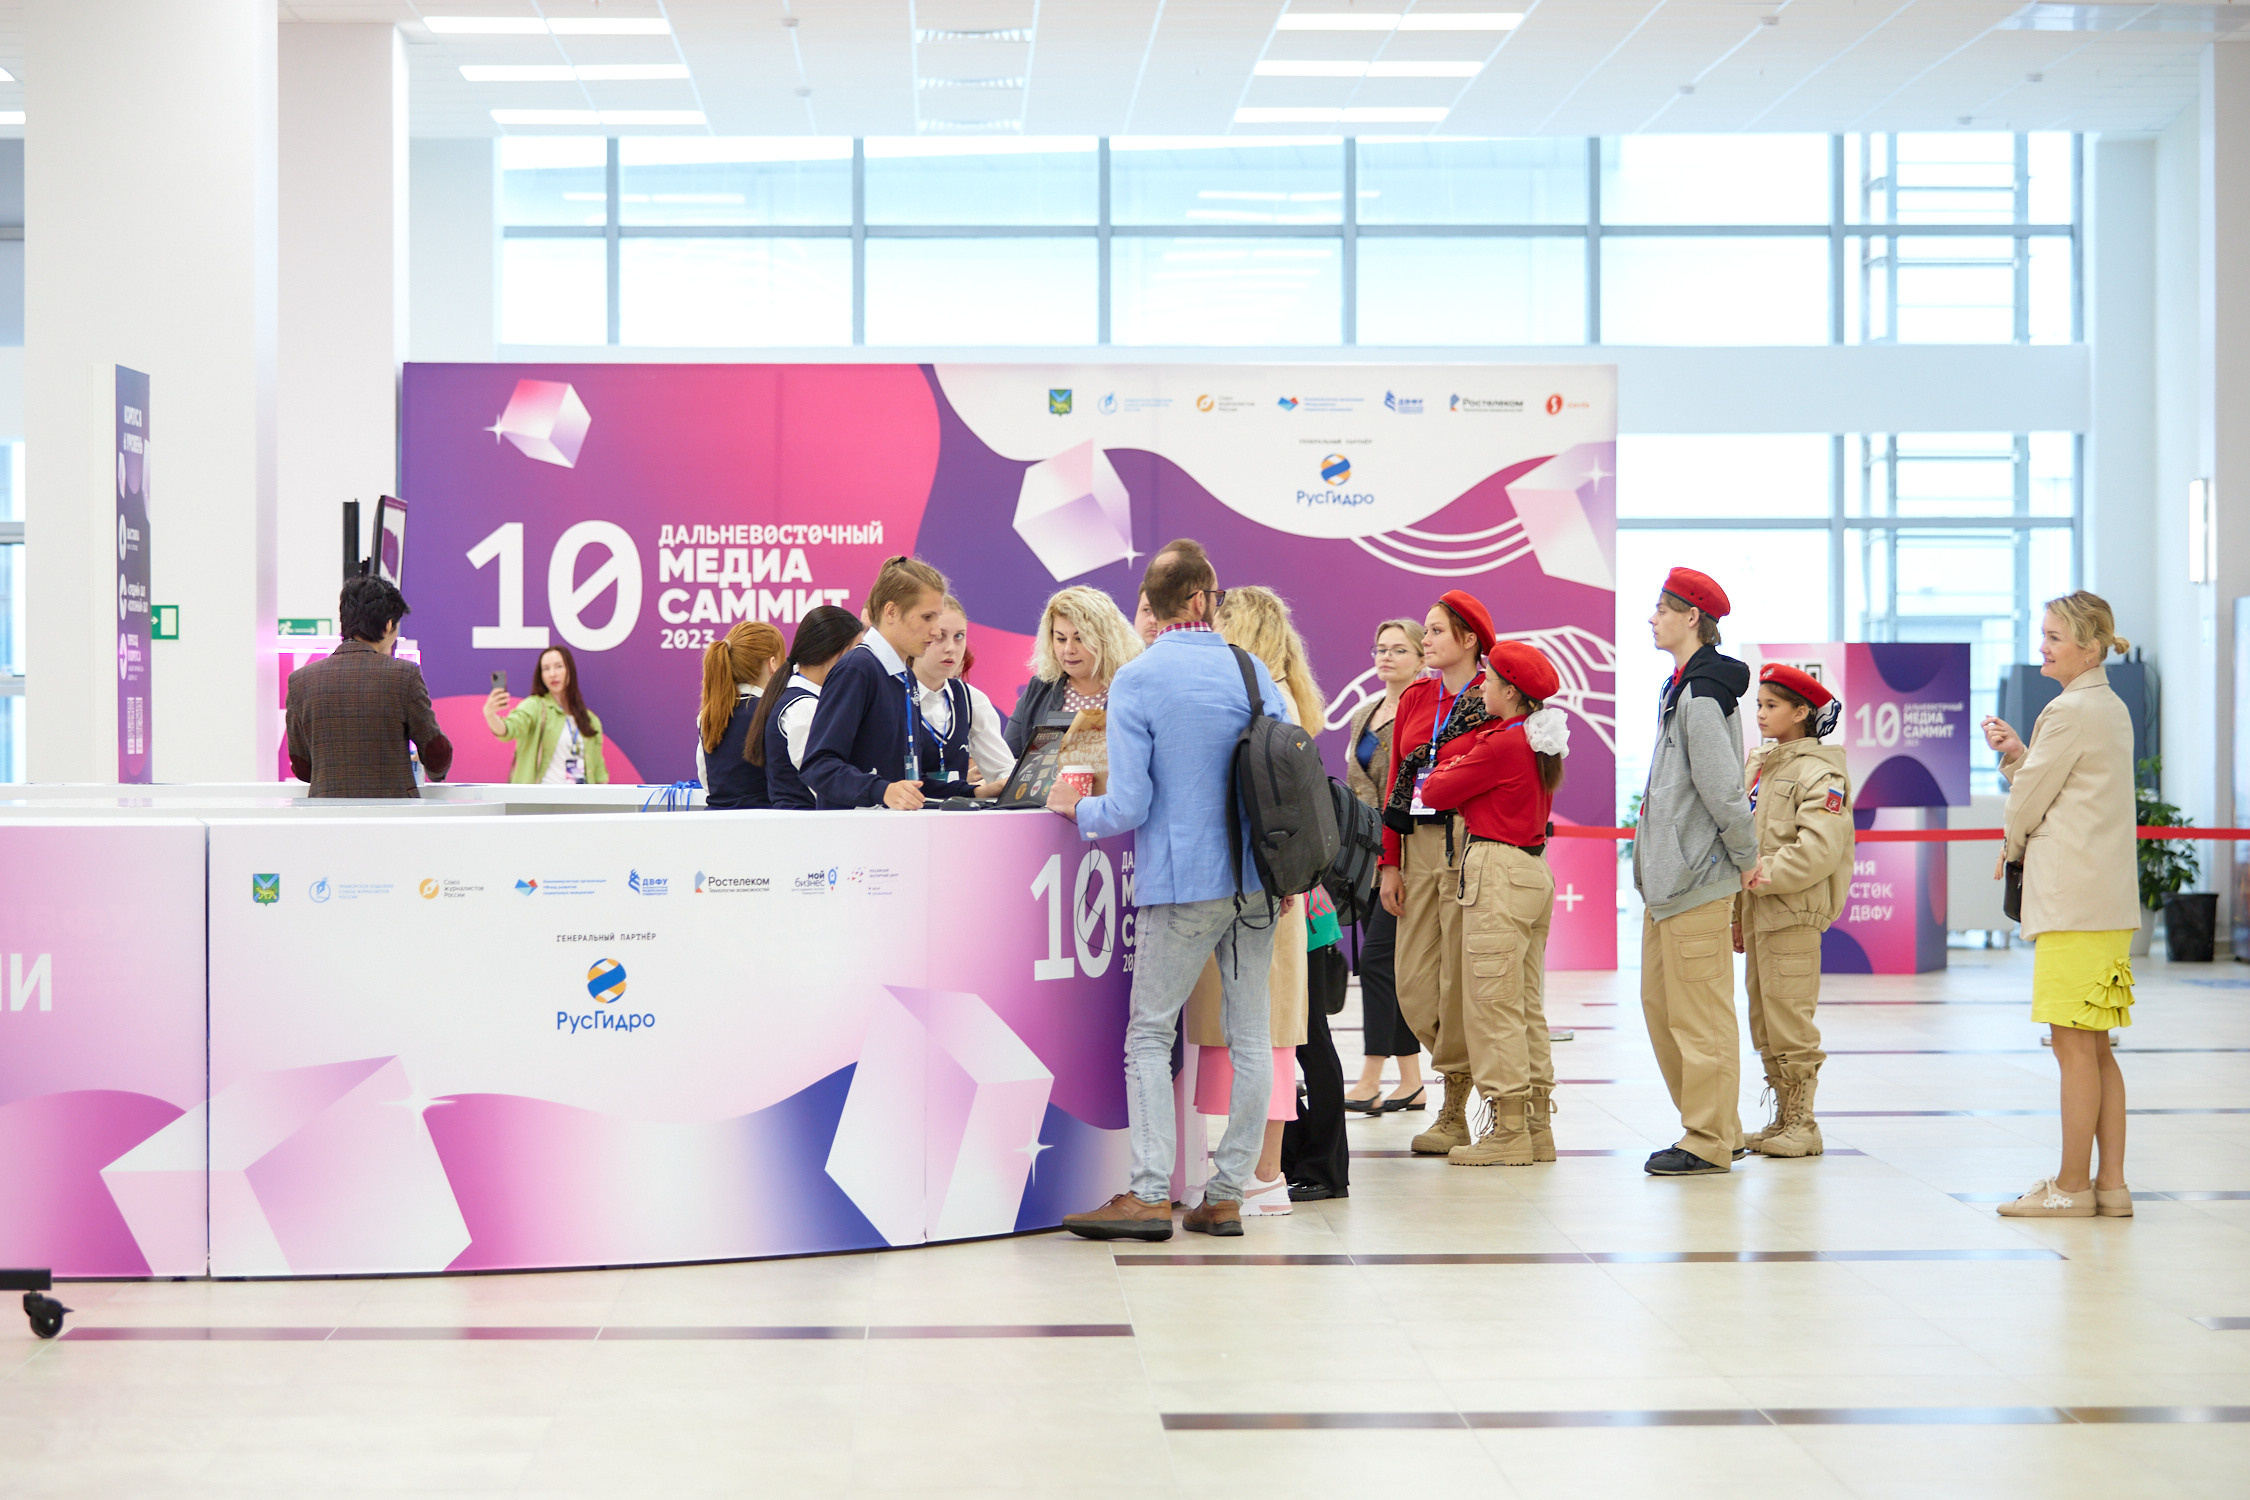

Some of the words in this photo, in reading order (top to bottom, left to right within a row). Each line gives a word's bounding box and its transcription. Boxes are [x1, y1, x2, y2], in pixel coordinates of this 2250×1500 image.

[1296, 490, 1375, 507] РусГидро
[658, 521, 884, 547] ДАЛЬНЕВОСТОЧНЫЙ
[658, 548, 813, 589] МЕДИА
[466, 520, 643, 652] 10
[657, 588, 850, 625] САММИТ
[660, 628, 716, 649] 2023
[1854, 701, 1901, 748] 10
[1903, 712, 1944, 726] МЕДИА
[1903, 724, 1954, 738] САММИТ
[1853, 860, 1876, 876] НЯ
[642, 878, 668, 886] ДВФУ
[708, 876, 770, 887] Ростелеком
[794, 878, 825, 888] бизнес
[1030, 849, 1116, 981] 10
[1848, 904, 1894, 923] ДВФУ
[556, 933, 615, 942] ГЕНЕРАЛЬНЫЙ
[620, 932, 657, 941] ПАРТНЁР
[0, 953, 52, 1011] И
[557, 1010, 656, 1034] РусГидро
